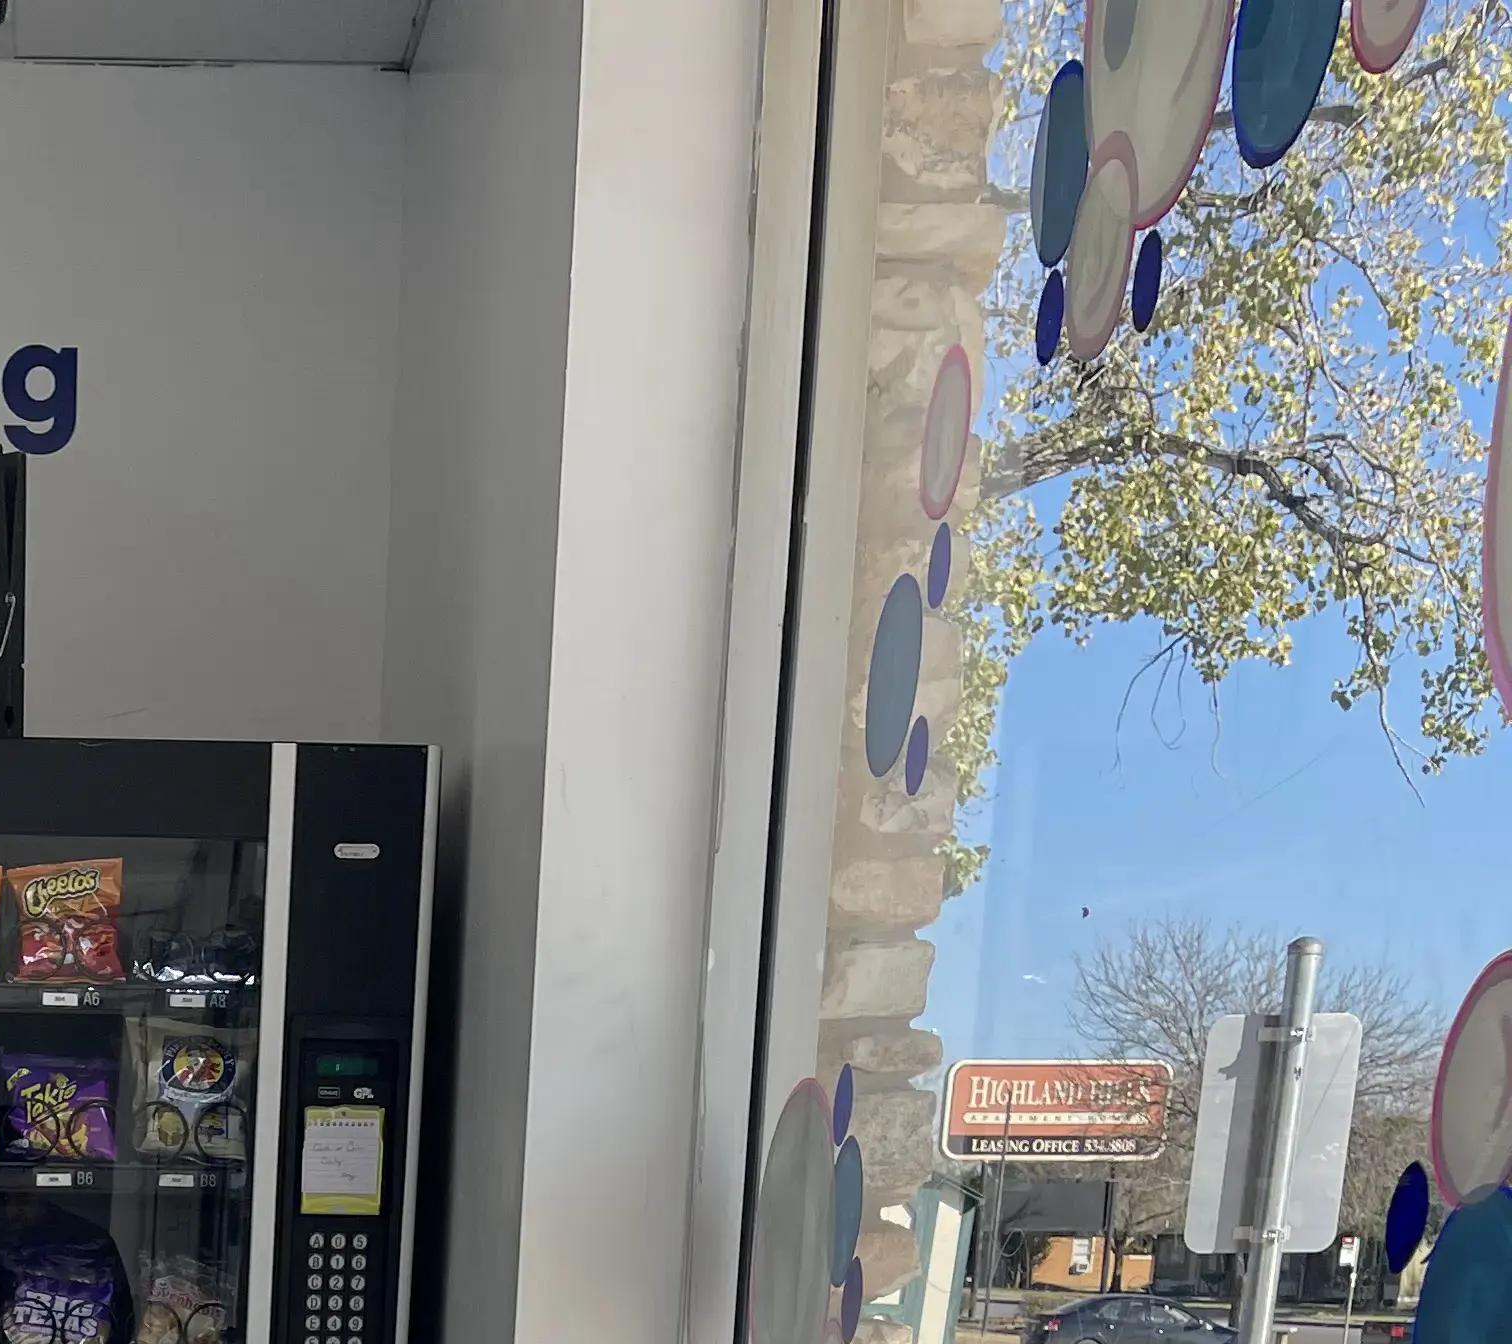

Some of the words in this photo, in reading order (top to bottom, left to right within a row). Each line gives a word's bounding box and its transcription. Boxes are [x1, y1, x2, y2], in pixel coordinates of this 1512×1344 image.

[24, 870, 99, 918] Cheetos
[83, 993, 100, 1007] A6
[209, 994, 226, 1008] A8
[971, 1138, 1029, 1153] LEASING
[1032, 1138, 1080, 1153] OFFICE
[76, 1171, 93, 1185] B6
[200, 1173, 216, 1188] B8
[23, 1289, 94, 1317] BIG
[12, 1304, 99, 1337] TEXAS
